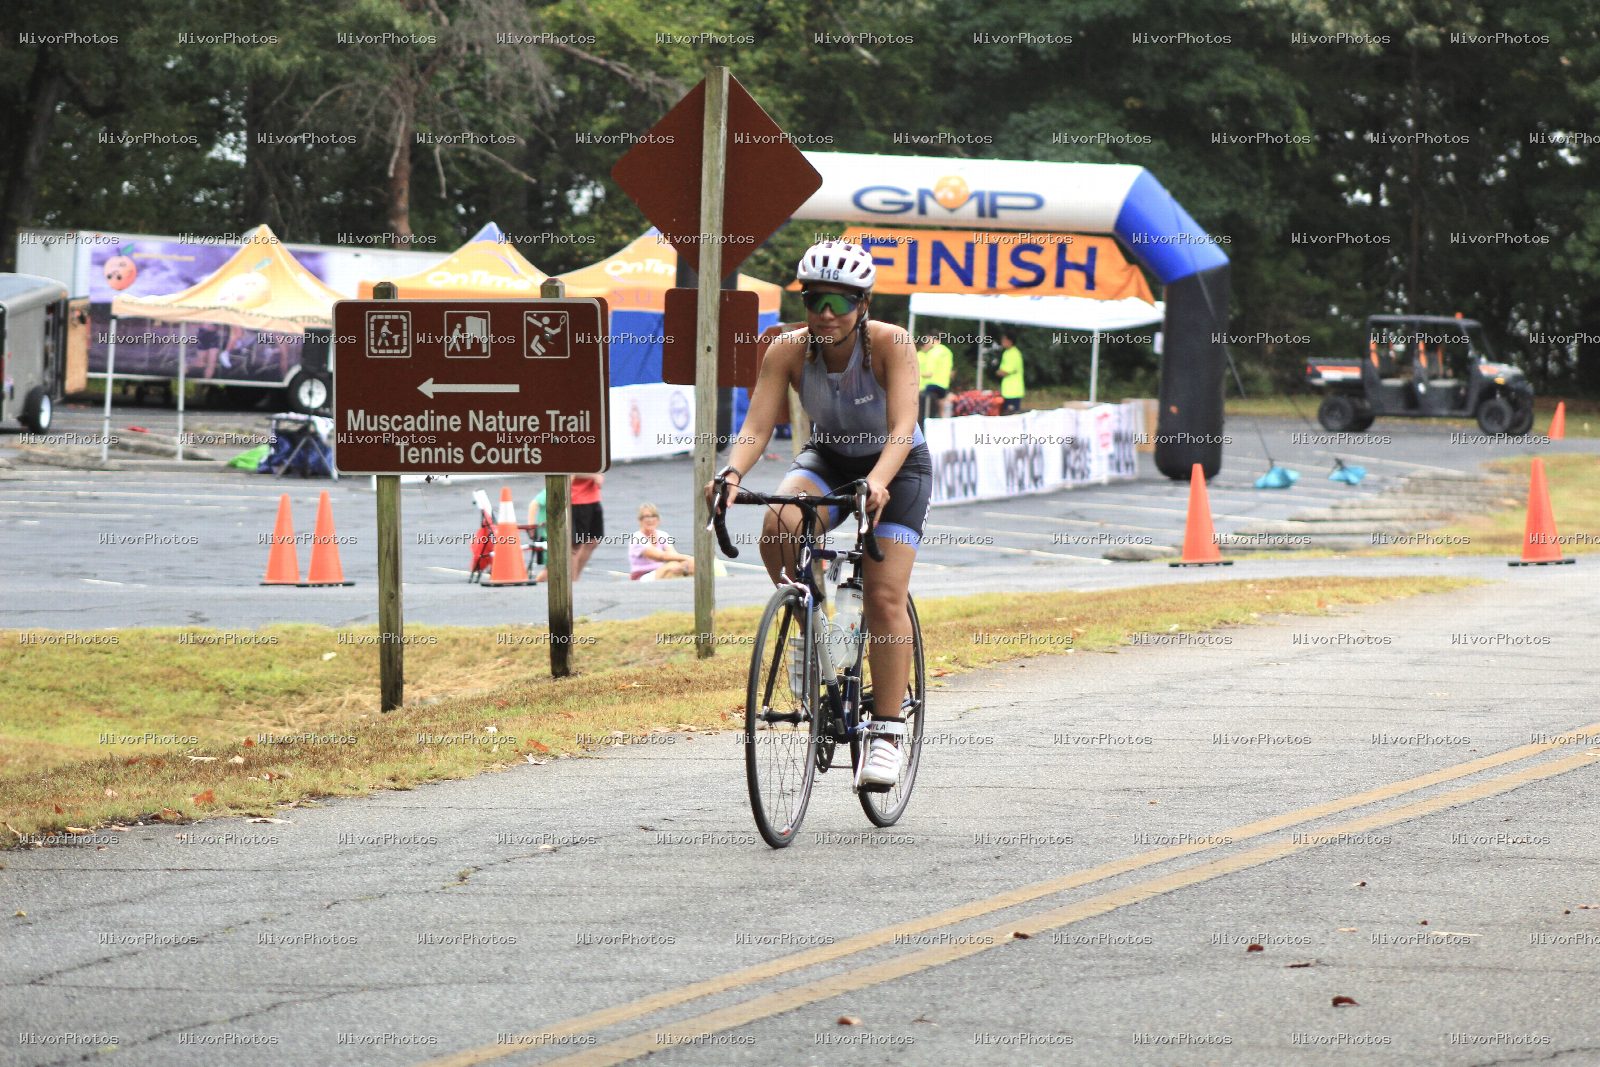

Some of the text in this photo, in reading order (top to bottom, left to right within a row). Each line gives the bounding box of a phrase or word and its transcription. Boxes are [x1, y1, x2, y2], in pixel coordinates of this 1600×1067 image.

[852, 184, 1045, 218] GMP
[820, 268, 840, 280] 116
[347, 409, 590, 432] Muscadine Nature Trail
[396, 442, 542, 464] Tennis Courts
